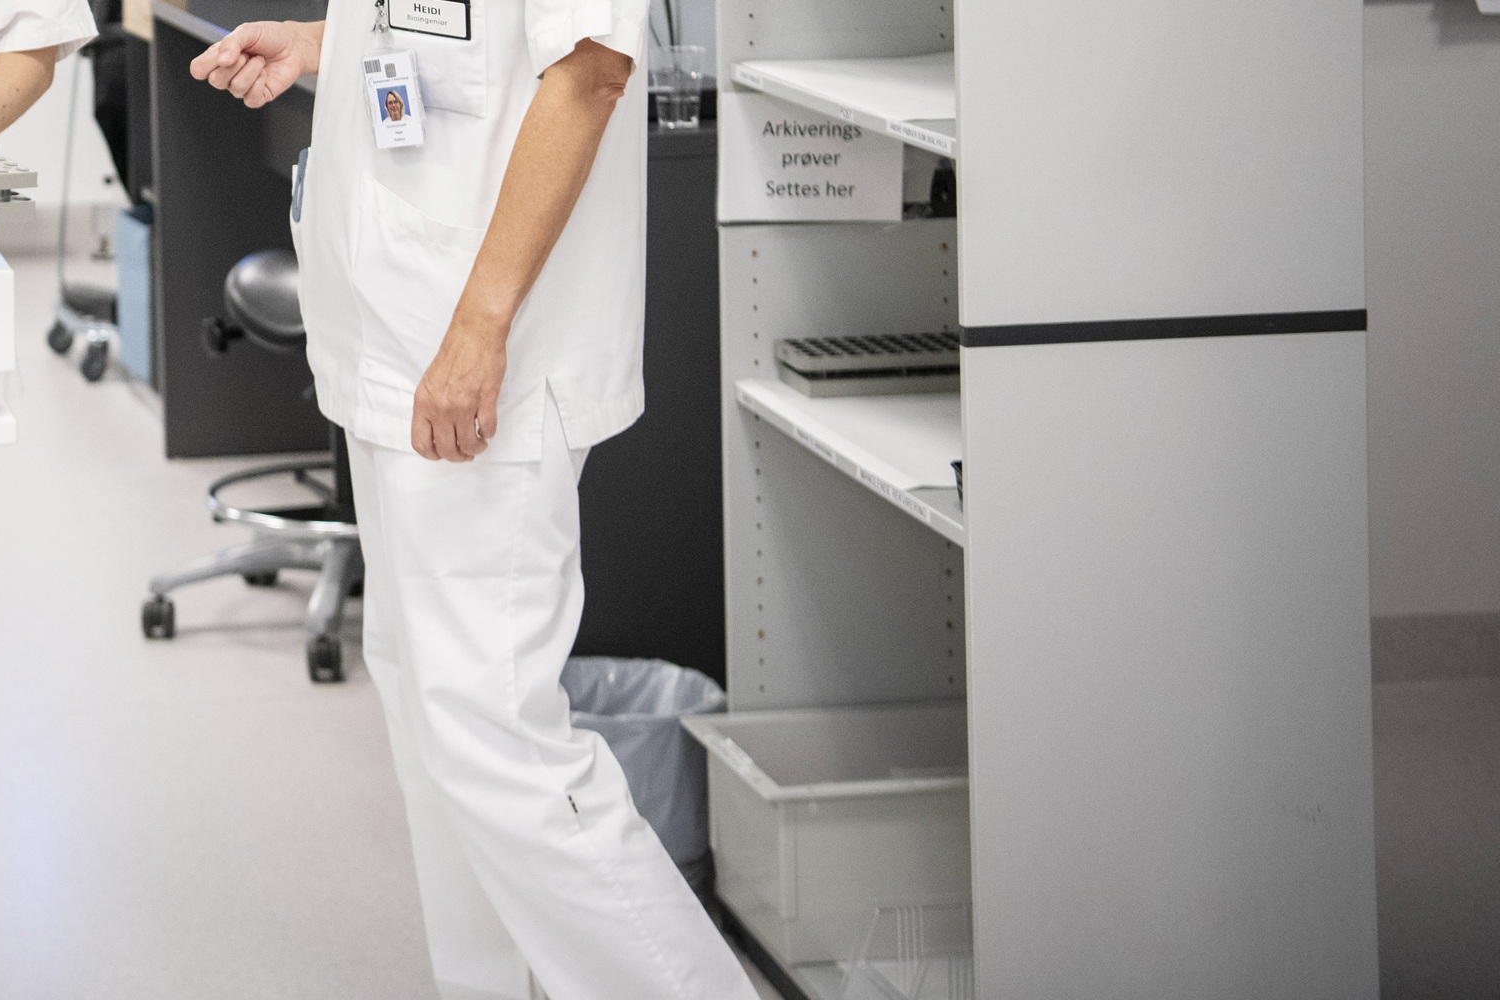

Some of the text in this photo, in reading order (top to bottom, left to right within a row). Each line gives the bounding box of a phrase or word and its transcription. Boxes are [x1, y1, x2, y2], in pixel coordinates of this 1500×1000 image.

[413, 3, 441, 16] HEIDI
[406, 14, 448, 27] Bioingeniør
[762, 120, 862, 141] Arkiverings
[782, 151, 841, 168] prøver
[766, 180, 856, 198] Settes her
